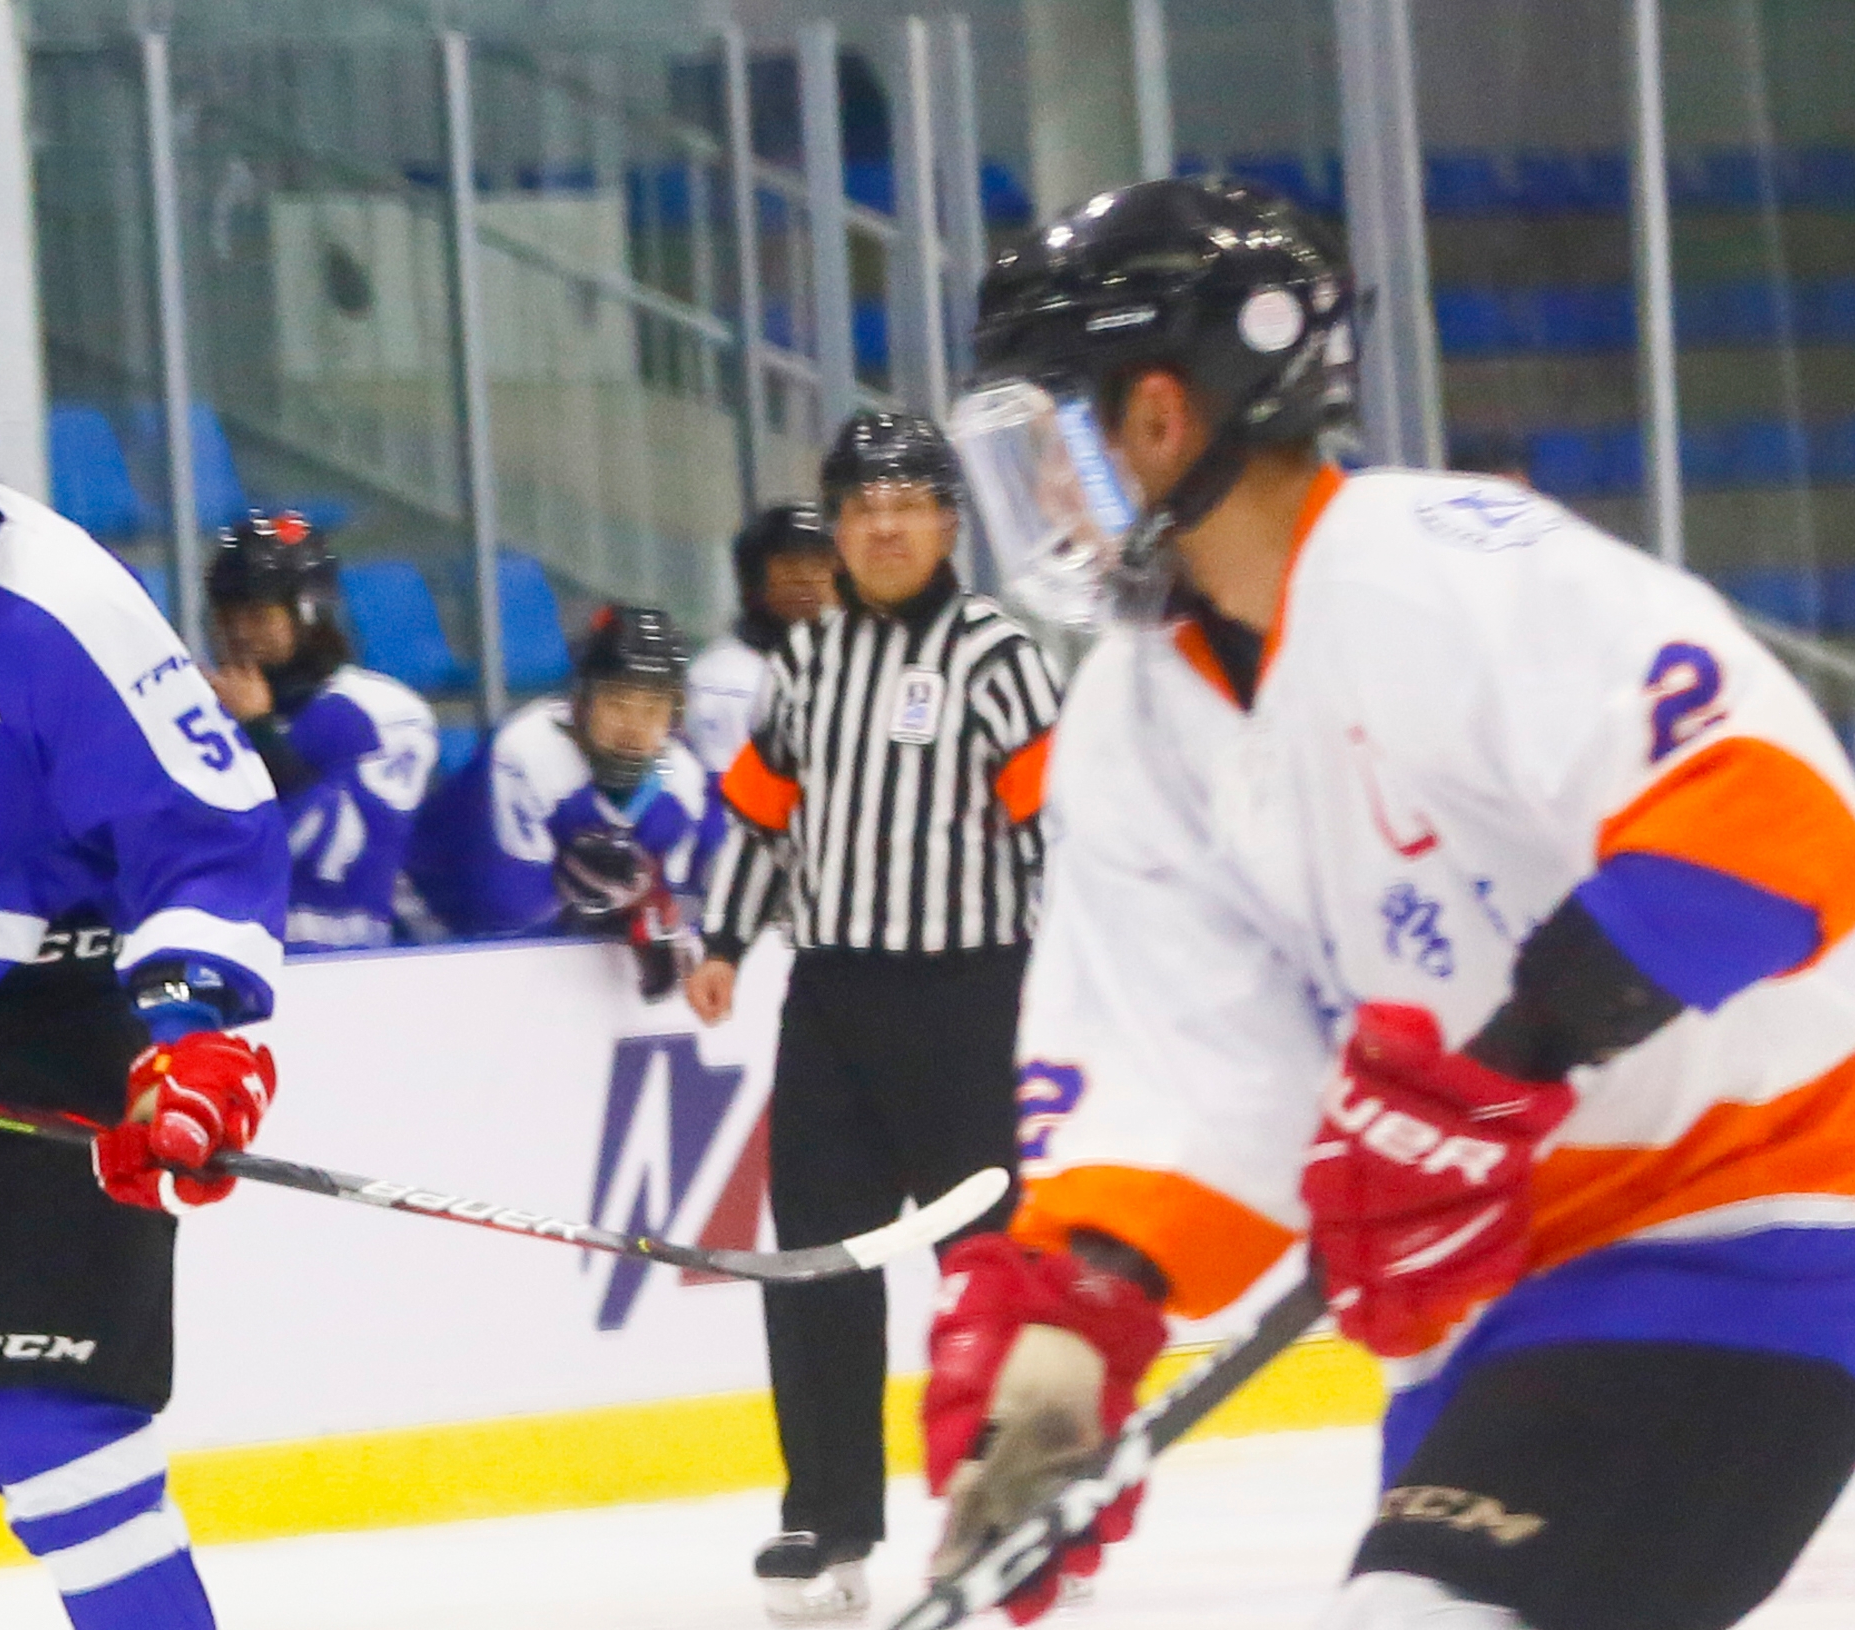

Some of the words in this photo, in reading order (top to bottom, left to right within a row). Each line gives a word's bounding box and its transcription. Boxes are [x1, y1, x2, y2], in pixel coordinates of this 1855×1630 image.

[131, 655, 192, 698] TR
[1643, 640, 1728, 764] 2
[173, 704, 253, 772] 5
[38, 926, 123, 963] CC
